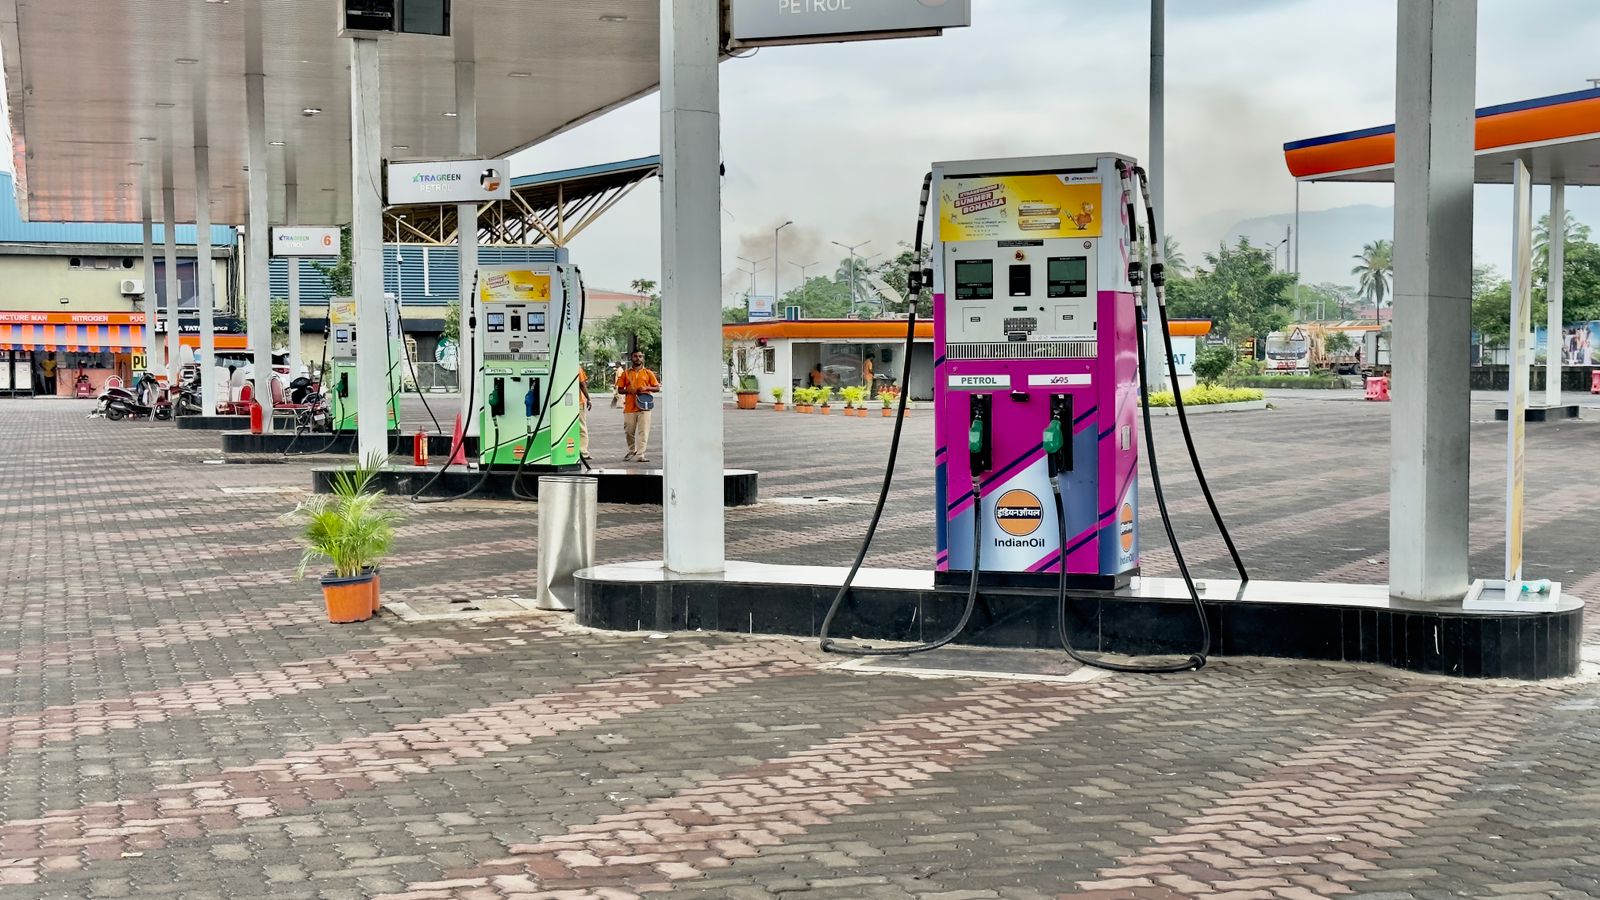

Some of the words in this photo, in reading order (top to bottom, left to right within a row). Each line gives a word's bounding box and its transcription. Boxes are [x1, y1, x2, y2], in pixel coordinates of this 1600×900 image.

[779, 0, 851, 14] PETROL
[955, 193, 992, 207] SUMMER
[964, 198, 1004, 213] BONANZA
[323, 235, 332, 246] 6
[997, 507, 1041, 518] इंडियनऑयल
[994, 538, 1045, 548] IndianOil
